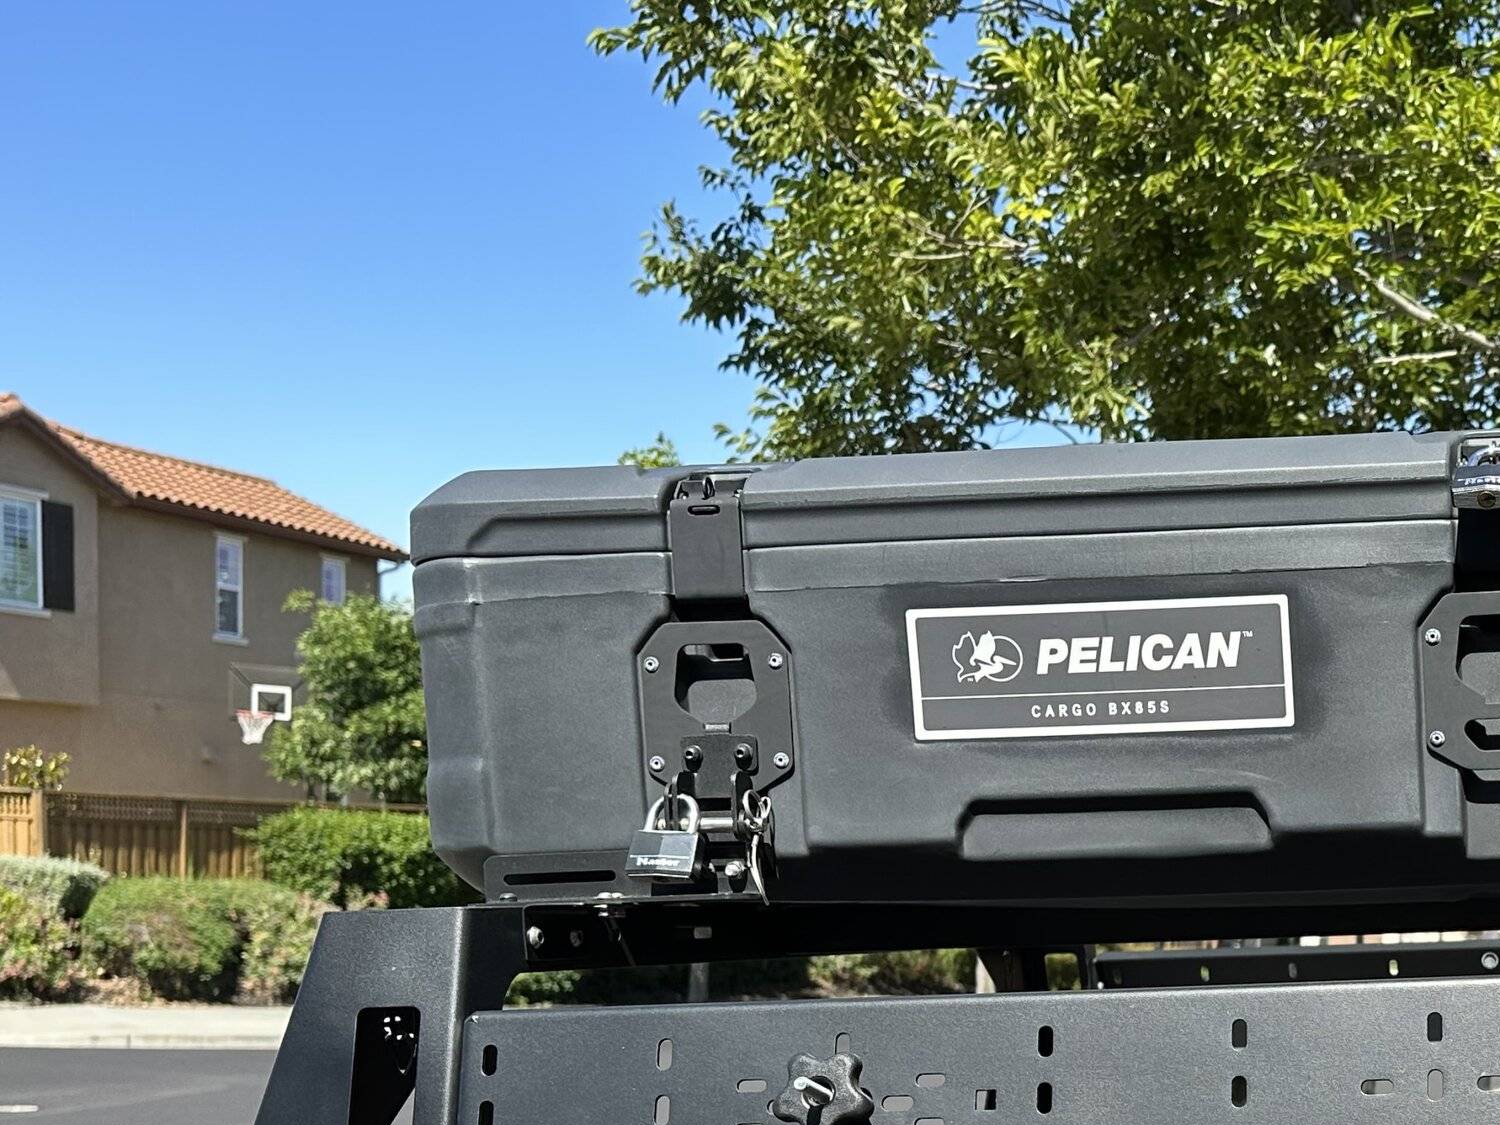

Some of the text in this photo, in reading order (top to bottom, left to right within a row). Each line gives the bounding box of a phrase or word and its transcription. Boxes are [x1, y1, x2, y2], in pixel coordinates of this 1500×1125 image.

[1036, 630, 1242, 675] PELICAN
[1031, 699, 1170, 719] CARGO BX85S
